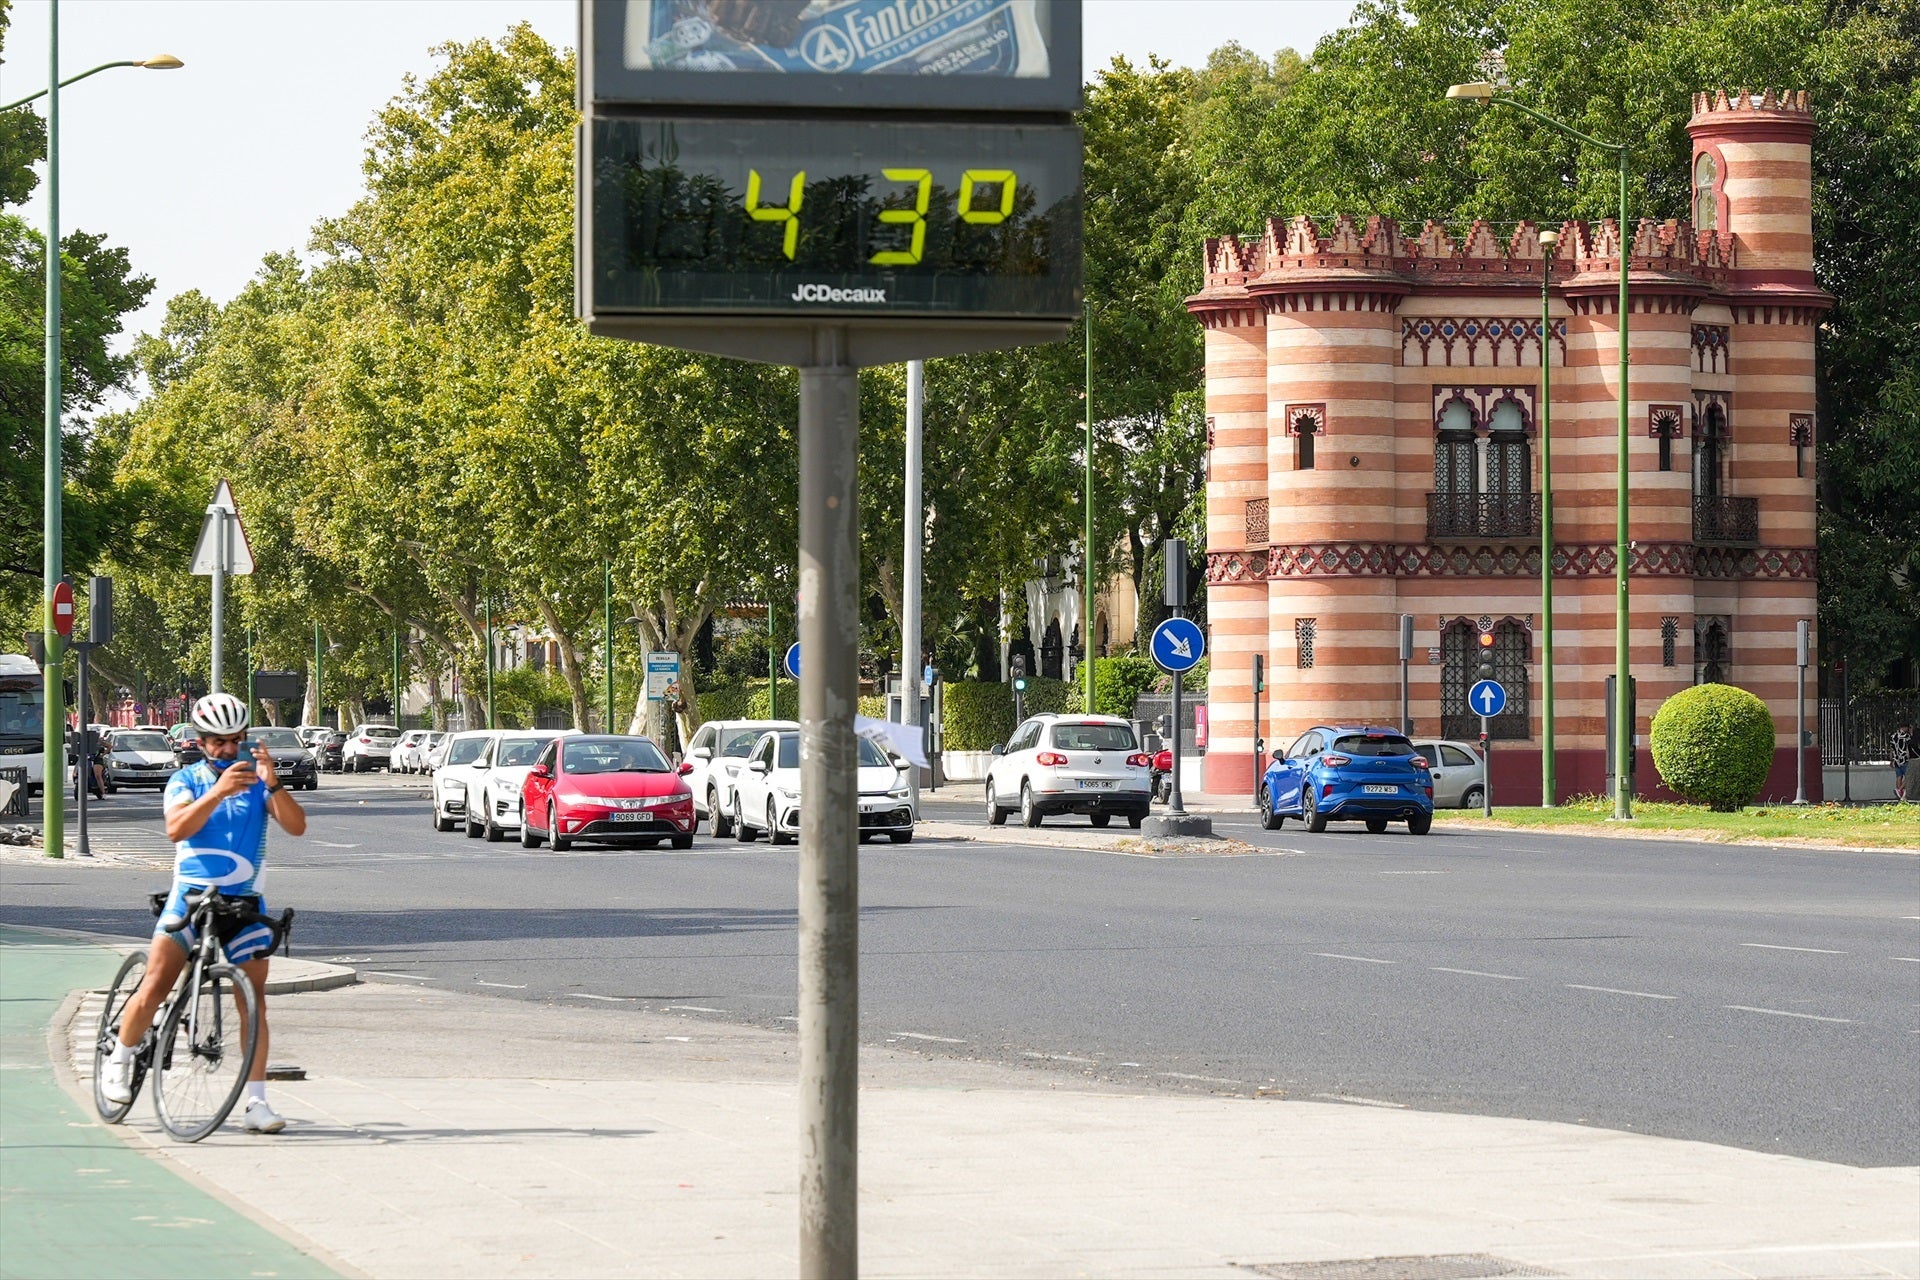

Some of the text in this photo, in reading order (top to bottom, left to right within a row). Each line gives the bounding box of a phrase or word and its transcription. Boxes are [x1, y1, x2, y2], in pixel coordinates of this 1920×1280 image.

[873, 20, 950, 61] PRIMEROS
[792, 284, 886, 303] JCDecaux
[615, 813, 635, 821] 9069
